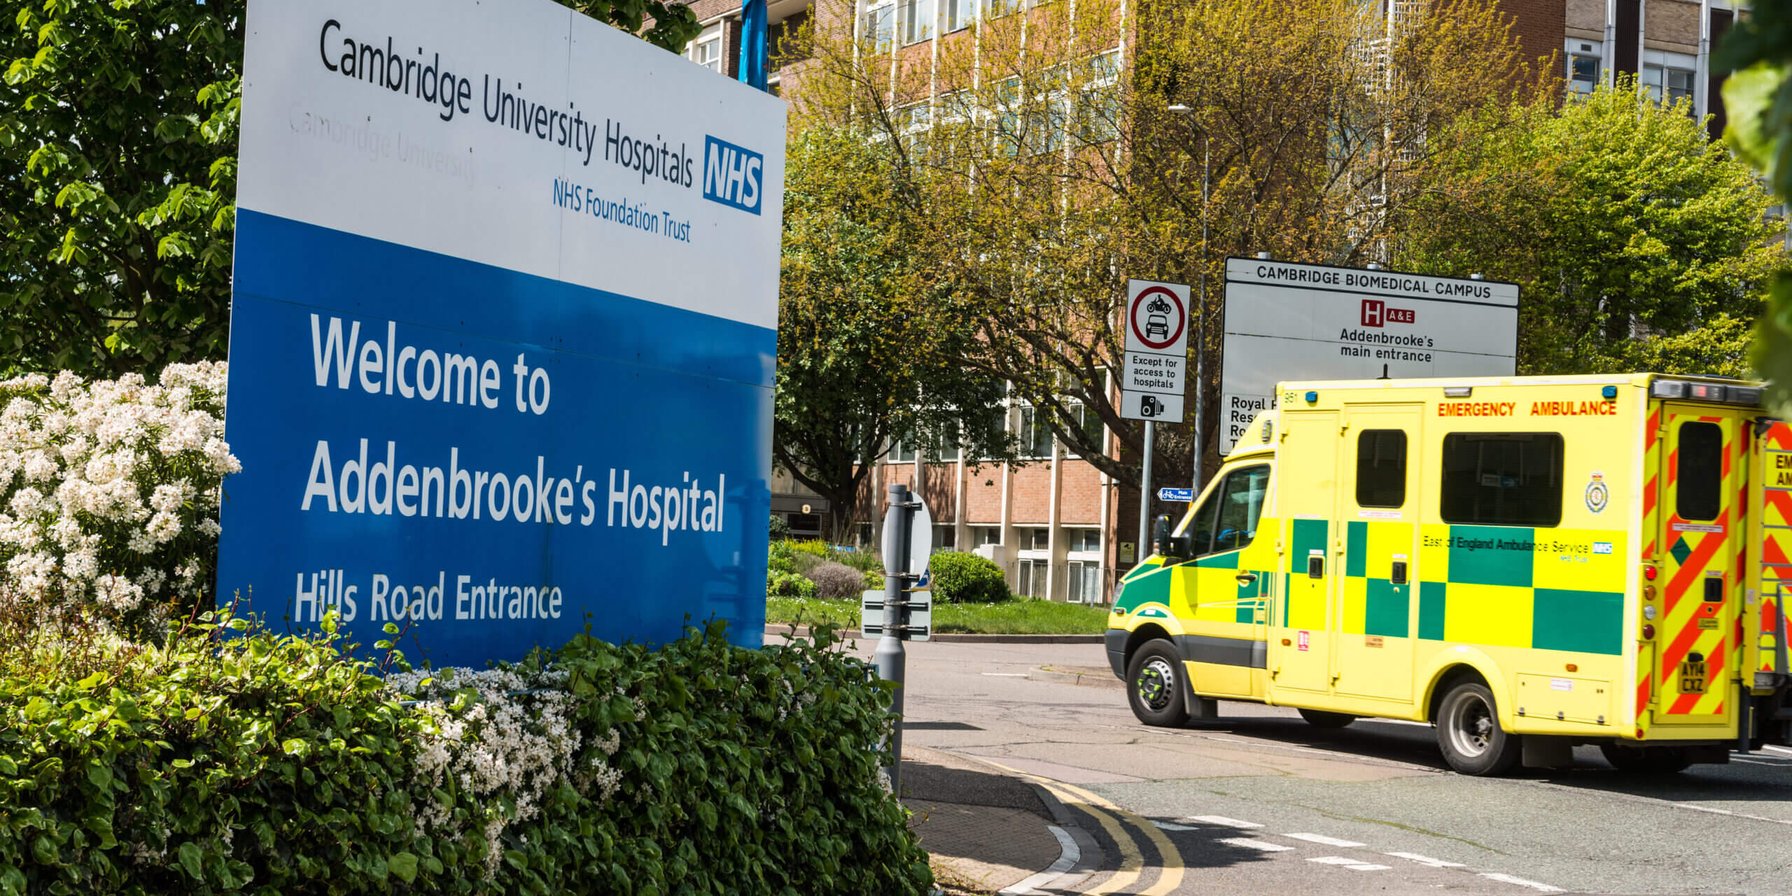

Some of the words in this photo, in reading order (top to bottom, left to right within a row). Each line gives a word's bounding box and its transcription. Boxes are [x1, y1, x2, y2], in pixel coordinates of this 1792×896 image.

[319, 19, 471, 122] Cambridge
[483, 74, 596, 166] University
[605, 119, 693, 189] Hospitals
[705, 138, 761, 211] NHS
[554, 178, 582, 213] NHS
[586, 188, 658, 233] Foundation
[662, 210, 691, 244] Trust
[1257, 266, 1340, 285] CAMBRIDGE
[1345, 274, 1429, 294] BIOMEDICAL
[1435, 282, 1491, 299] CAMPUS
[1365, 302, 1380, 325] H
[1389, 310, 1413, 322] A&E
[1340, 328, 1434, 348] Addenbrooke's
[1133, 356, 1162, 367] Except
[1166, 359, 1178, 368] for
[1340, 345, 1371, 358] main
[1376, 350, 1432, 363] entrance
[310, 313, 500, 409] Welcome
[513, 352, 551, 416] to
[1134, 368, 1163, 377] access
[1167, 370, 1175, 378] to
[1134, 377, 1174, 389] hospitals
[1231, 396, 1266, 411] Royal
[1438, 402, 1516, 417] EMERGENCY
[1530, 401, 1617, 416] AMBULANCE
[1231, 410, 1257, 424] Res
[301, 437, 596, 527] Addenbrooke's
[608, 468, 725, 546] Hospital
[1424, 535, 1442, 547] East
[1446, 536, 1455, 548] of
[1457, 536, 1494, 552] England
[1496, 538, 1548, 552] Ambulance
[1553, 541, 1588, 554] Service
[295, 569, 358, 623] Hills
[370, 571, 445, 621] Road
[455, 574, 562, 620] Entrance
